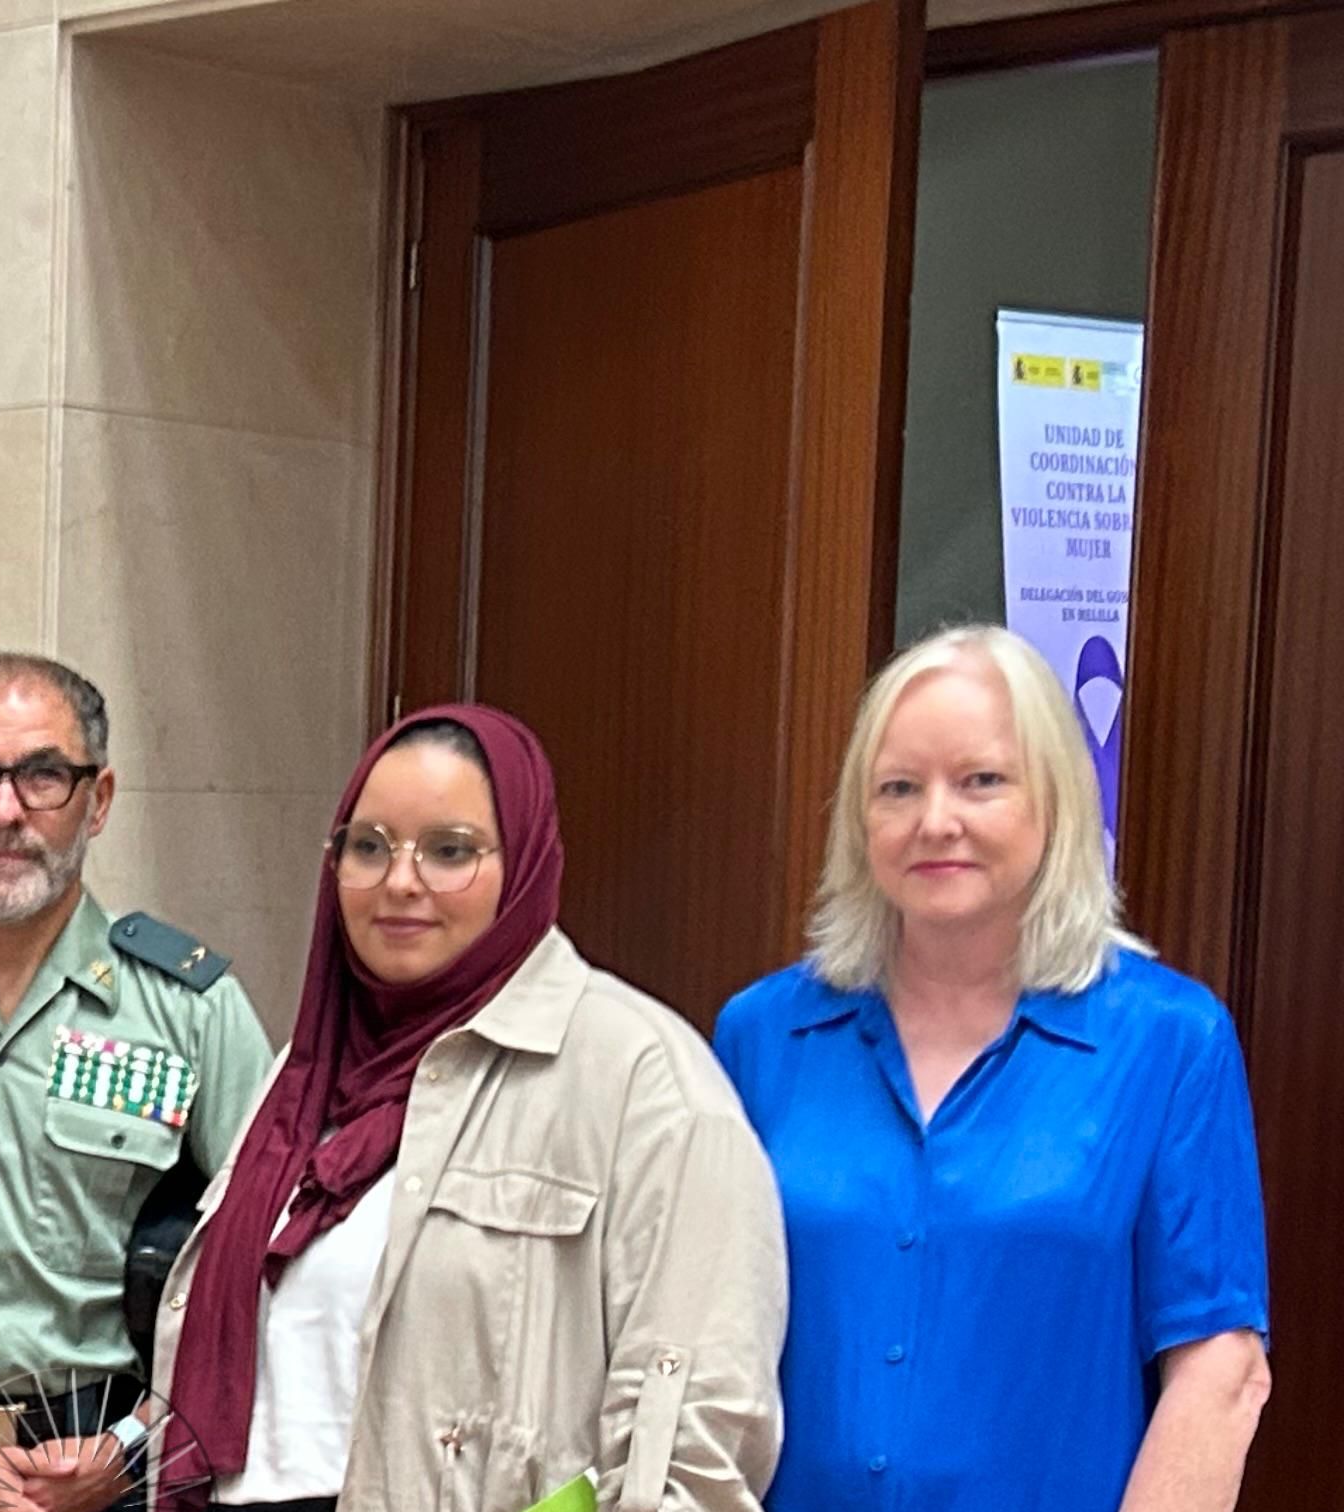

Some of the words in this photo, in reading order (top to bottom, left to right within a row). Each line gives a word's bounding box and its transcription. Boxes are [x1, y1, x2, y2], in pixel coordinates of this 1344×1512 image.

[1044, 423, 1101, 447] UNIDAD
[1105, 428, 1125, 449] DE
[1046, 480, 1105, 503] CONTRA
[1108, 483, 1126, 504] LA
[1011, 507, 1091, 531] VIOLENCIA
[1065, 537, 1112, 560] MUJER
